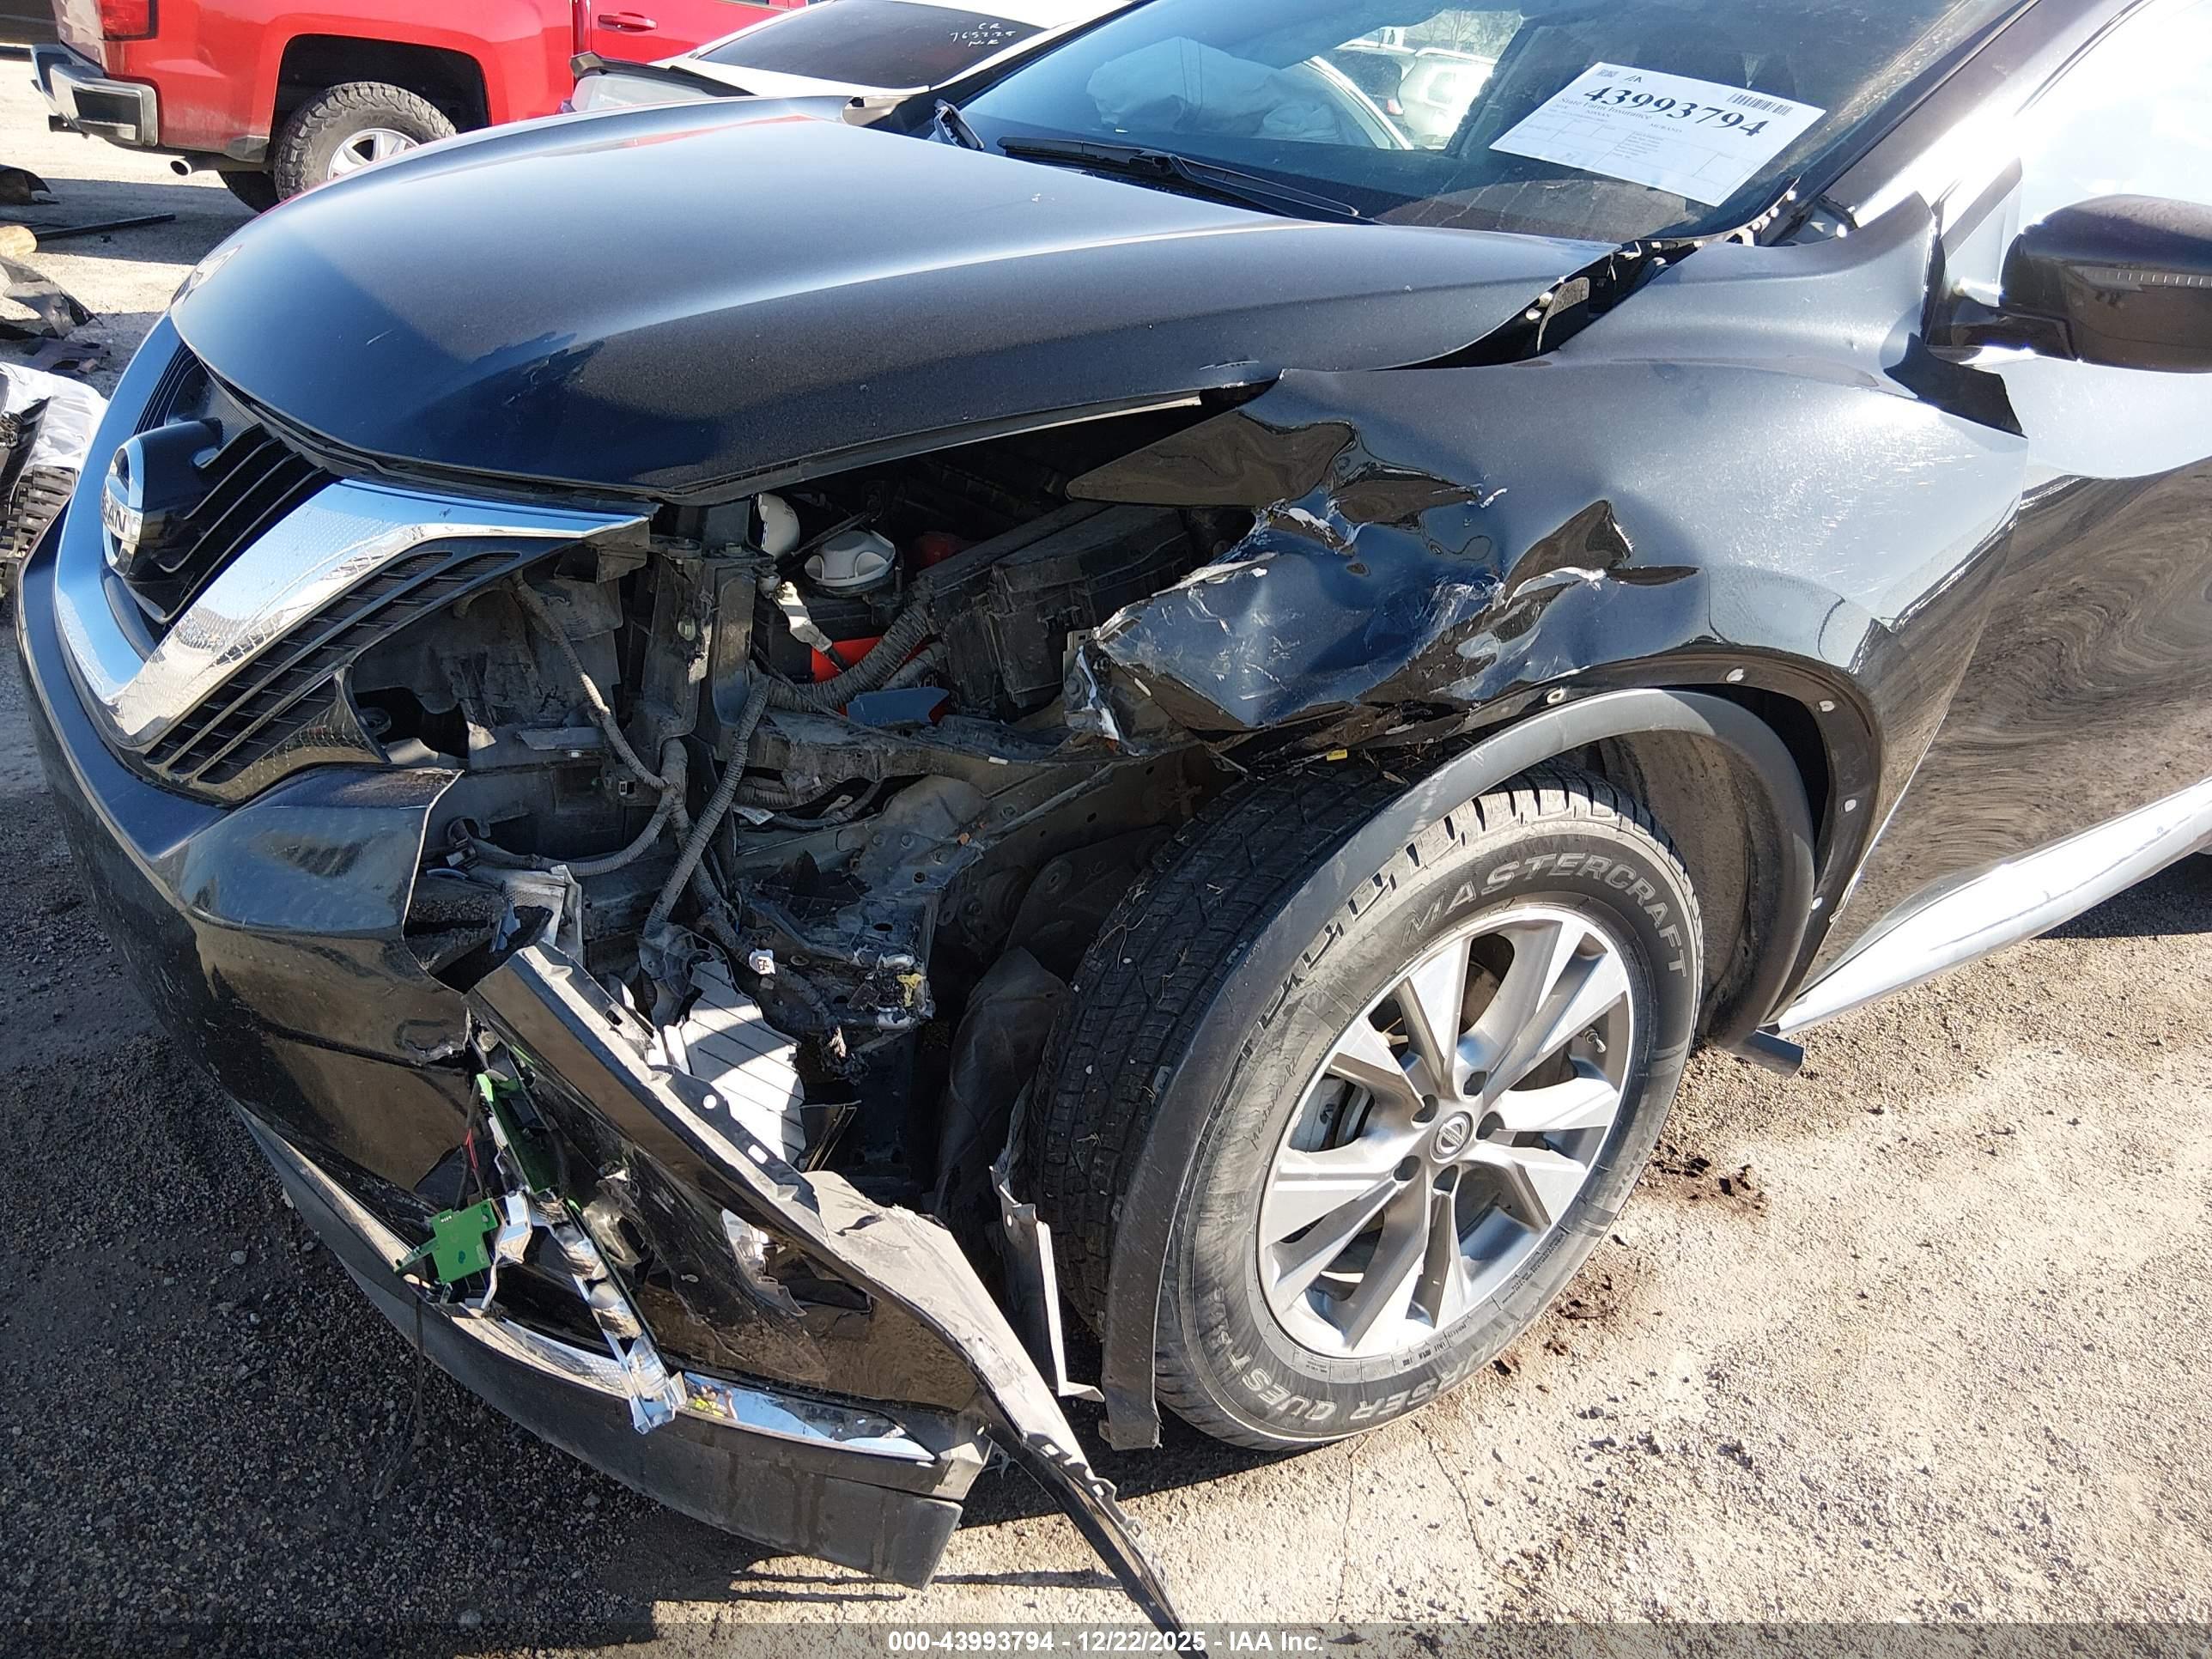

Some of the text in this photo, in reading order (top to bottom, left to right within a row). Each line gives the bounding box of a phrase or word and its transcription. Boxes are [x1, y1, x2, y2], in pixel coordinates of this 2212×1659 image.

[1560, 97, 1582, 106] State
[1582, 101, 1607, 111] Farm
[1583, 87, 1770, 137] 43993794
[1400, 853, 1688, 977] MASTERCRAFT
[1242, 1353, 1338, 1421] QUEST
